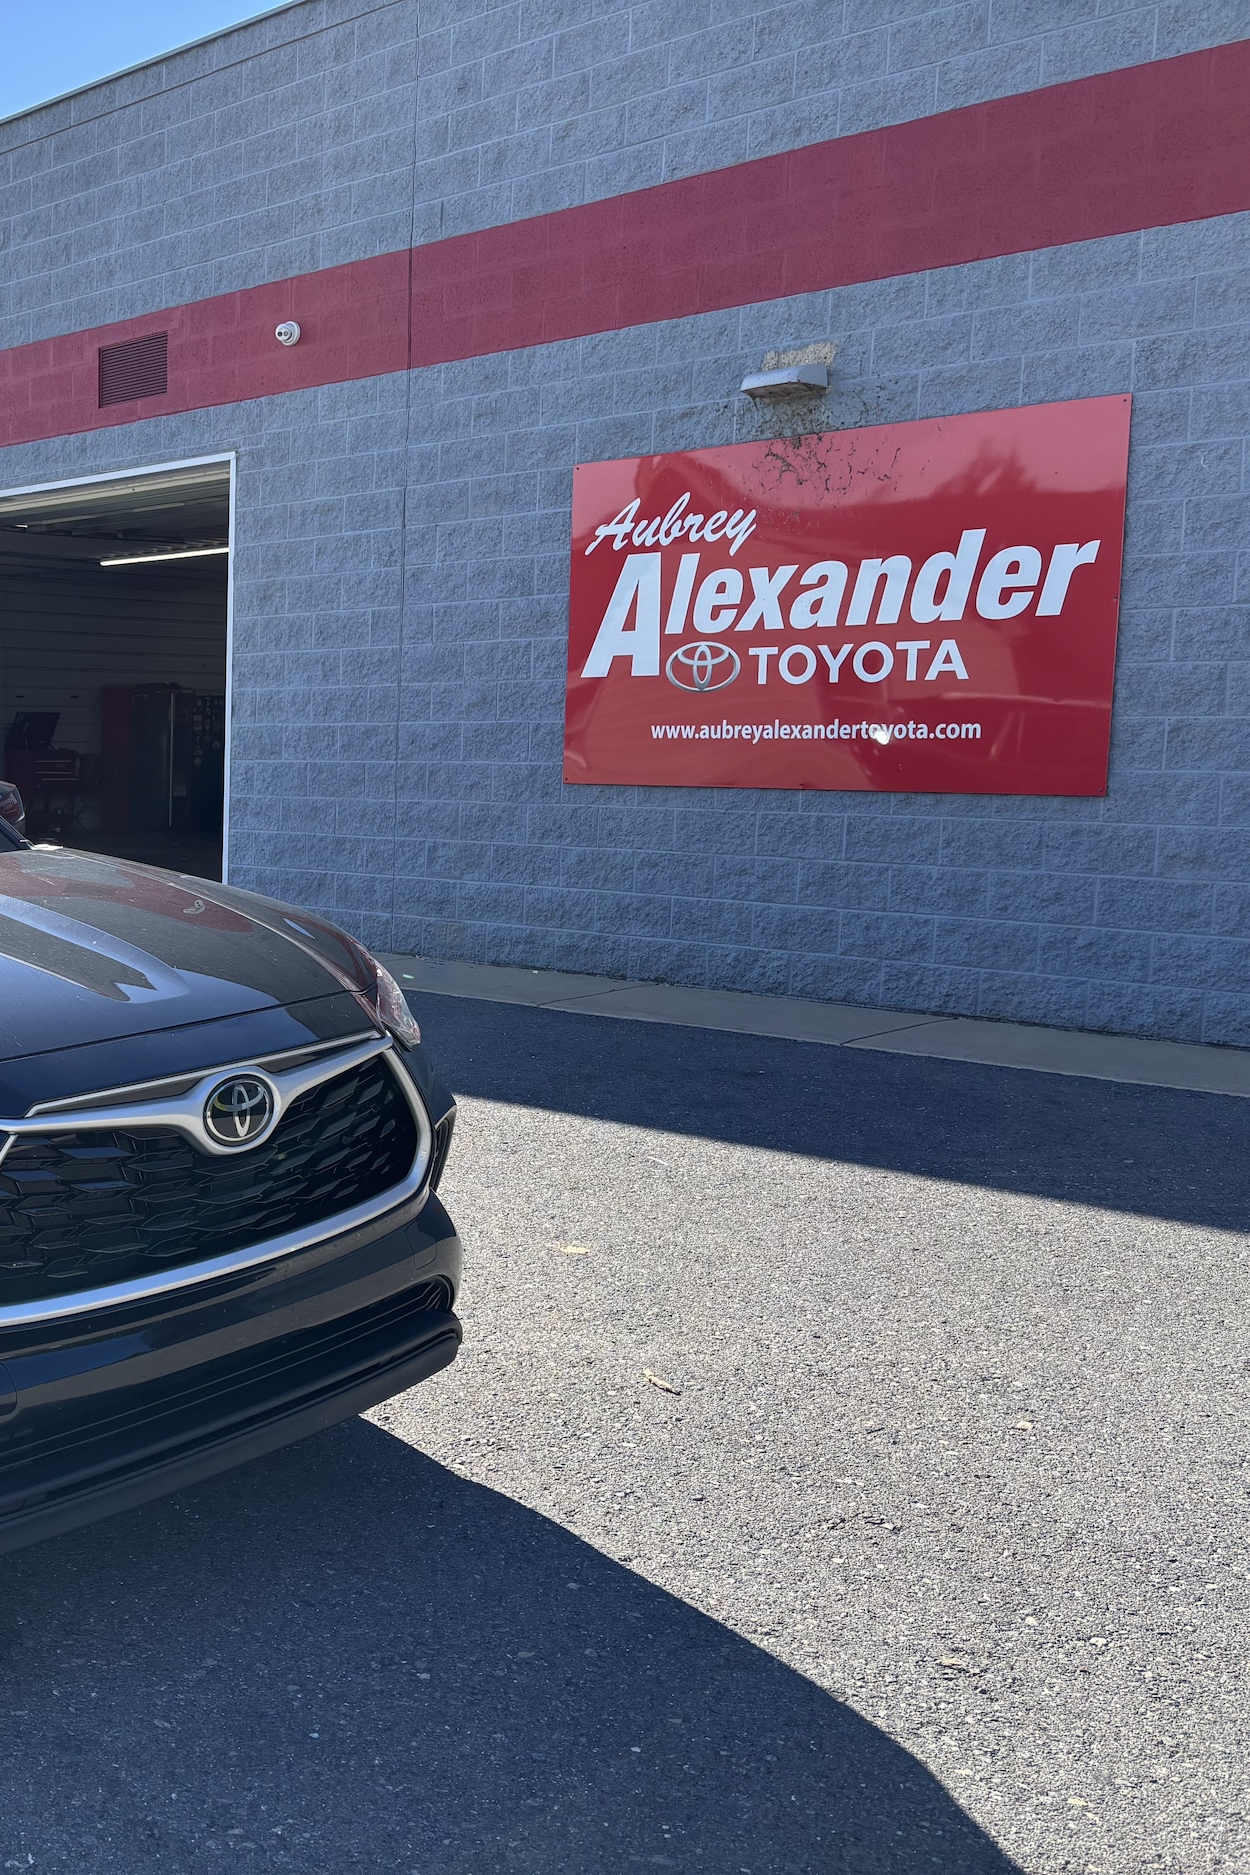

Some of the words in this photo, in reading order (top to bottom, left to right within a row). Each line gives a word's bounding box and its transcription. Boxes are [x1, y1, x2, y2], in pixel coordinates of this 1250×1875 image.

[584, 492, 757, 556] Aubrey
[581, 528, 1101, 678] Alexander
[748, 639, 969, 685] TOYOTA
[650, 719, 982, 745] www.aubreyalexandertoyota.com
